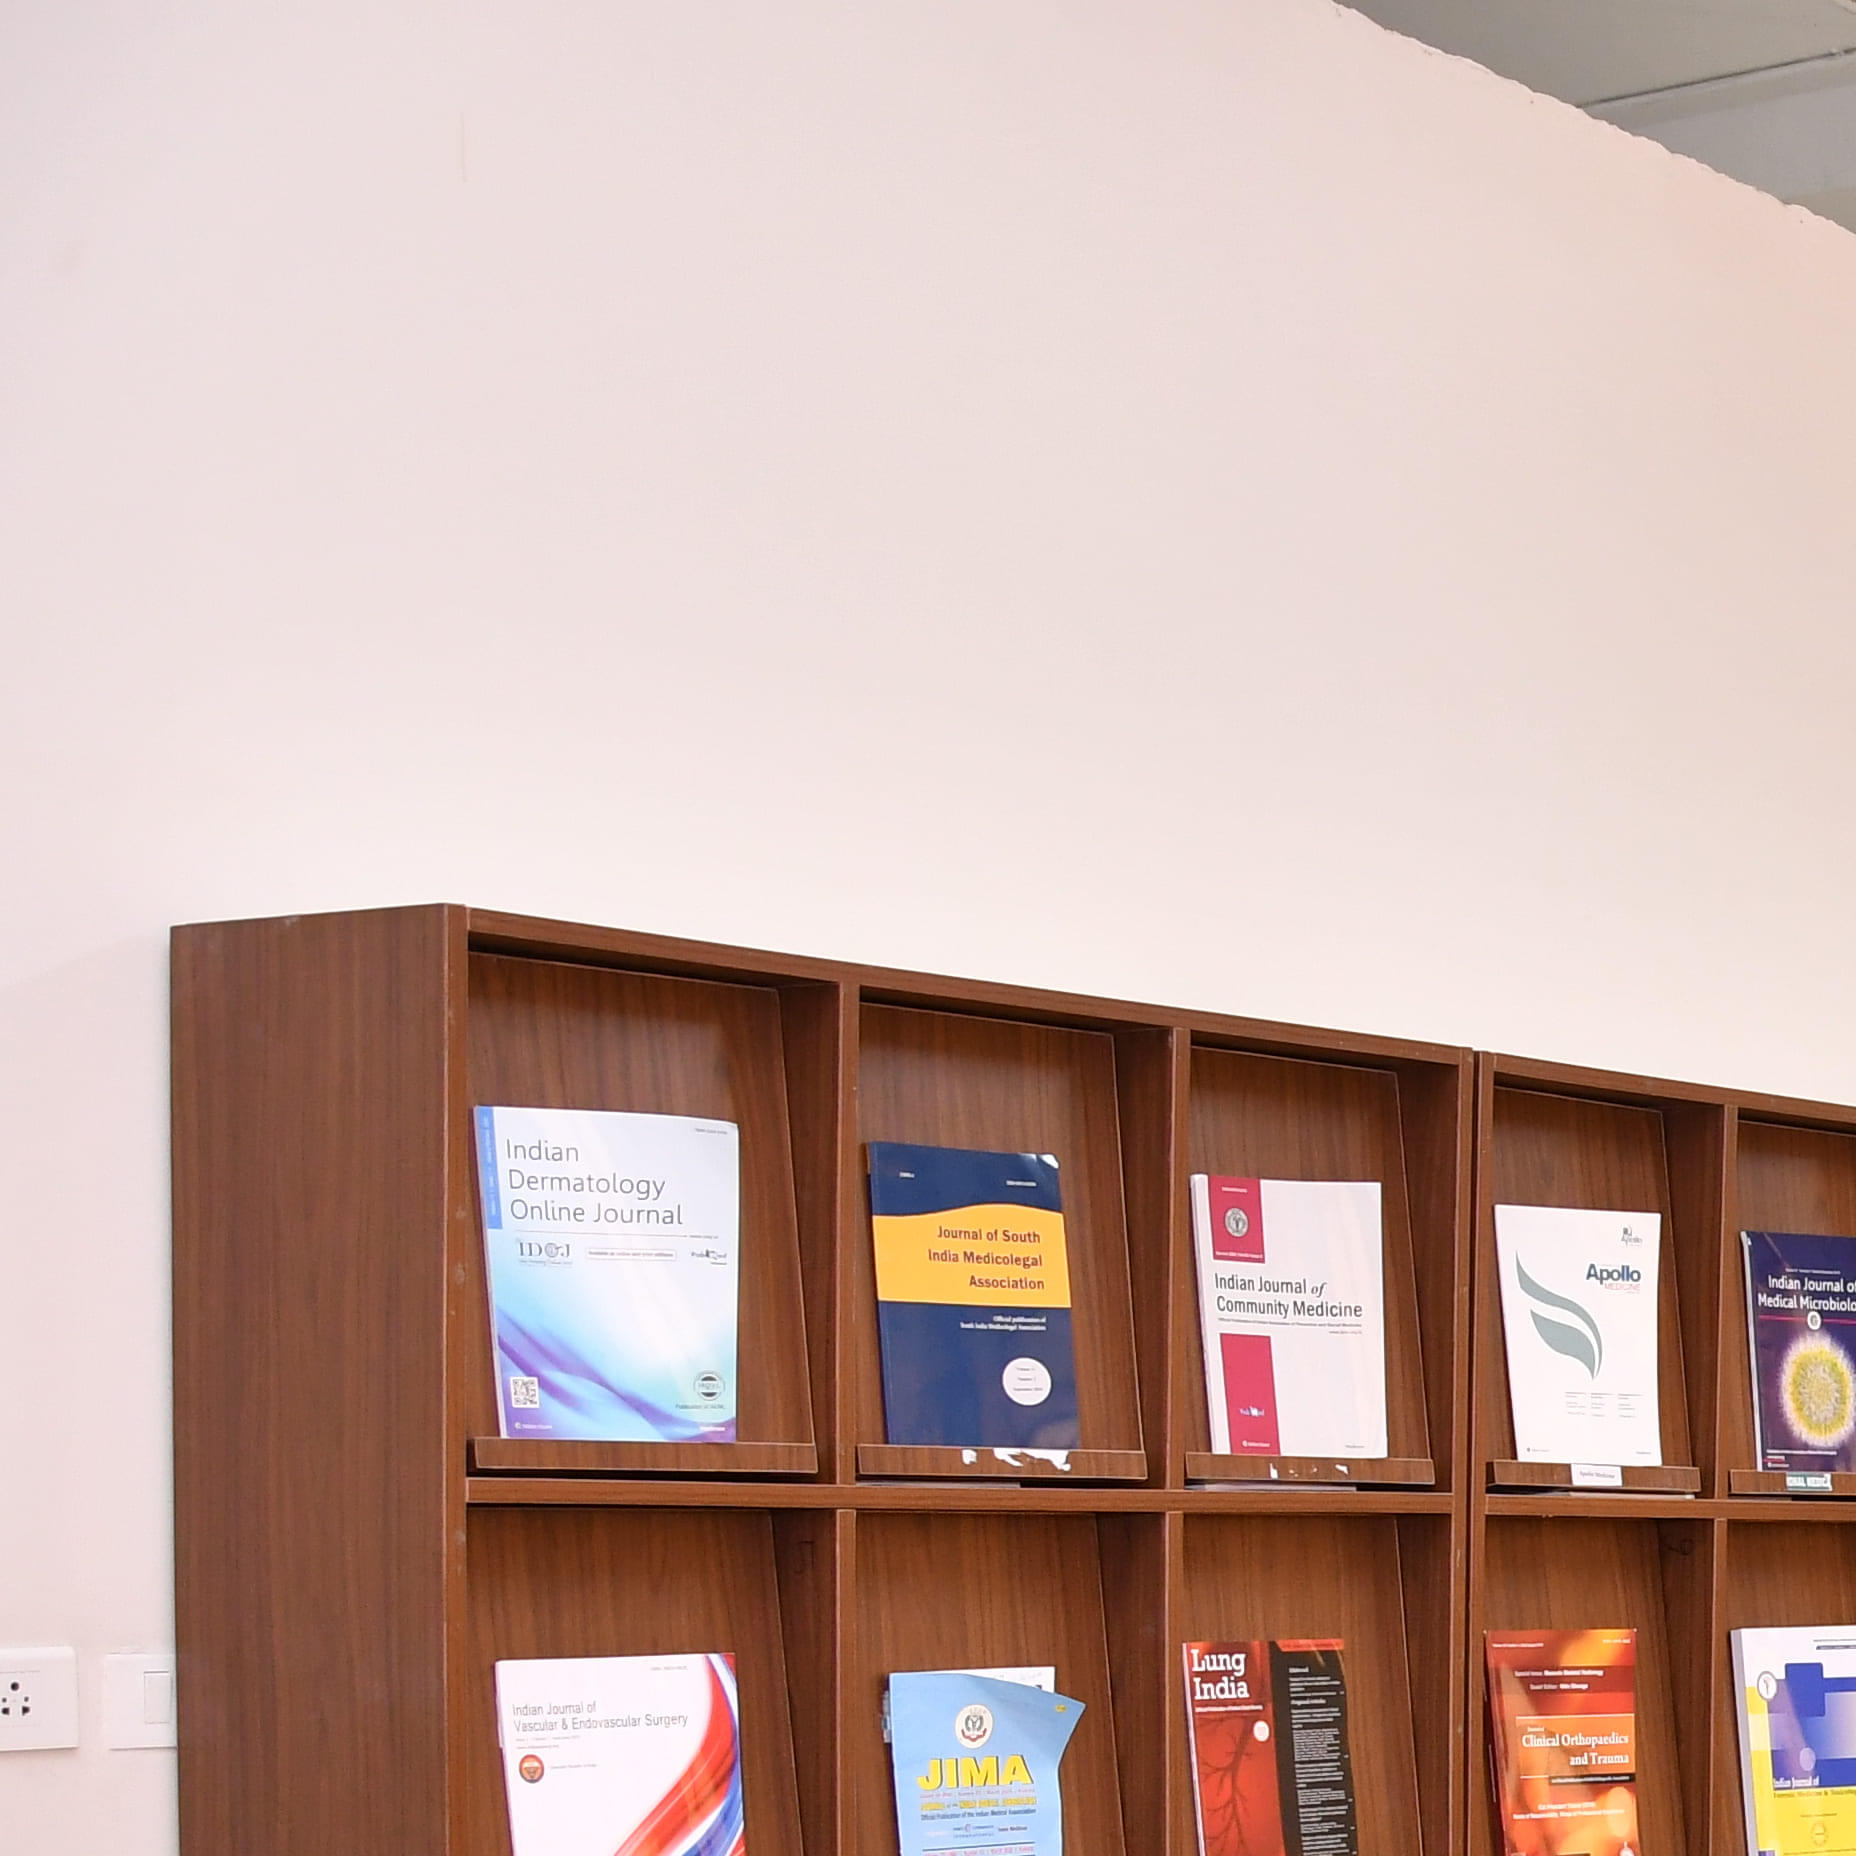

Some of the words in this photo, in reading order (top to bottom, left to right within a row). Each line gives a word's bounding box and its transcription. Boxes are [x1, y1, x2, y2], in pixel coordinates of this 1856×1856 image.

[507, 1139, 578, 1162] Indian
[509, 1170, 665, 1200] Dermatology
[511, 1199, 584, 1222] Online
[593, 1203, 682, 1224] Journal
[938, 1226, 982, 1241] Journal
[986, 1229, 998, 1241] of
[1002, 1230, 1040, 1243] South
[928, 1249, 959, 1262] India
[964, 1251, 1042, 1269] Medicolegal
[970, 1275, 1044, 1290] Association
[1586, 1264, 1641, 1285] Apollo
[1768, 1275, 1800, 1290] Indian
[1803, 1277, 1844, 1292] Journal
[1215, 1273, 1254, 1291] Indian
[1258, 1276, 1306, 1294] Journal
[1311, 1282, 1327, 1298] of
[1217, 1296, 1289, 1318] Community
[1294, 1300, 1362, 1318] Medicine
[1758, 1294, 1798, 1308] Medical
[1191, 1649, 1246, 1676] Lung
[1193, 1676, 1250, 1700] India
[513, 1703, 544, 1716] Indian
[546, 1701, 583, 1716] Journal
[587, 1701, 596, 1714] of
[514, 1718, 558, 1732] Vascular
[561, 1718, 568, 1730] &
[572, 1715, 640, 1730] Endovascular
[645, 1713, 688, 1728] Surgery
[1522, 1734, 1560, 1748] Clinical
[1562, 1732, 1629, 1748] Orthopaedics
[1570, 1754, 1588, 1766] and
[1591, 1752, 1629, 1766] Trauma
[917, 1754, 1034, 1791] JIMA
